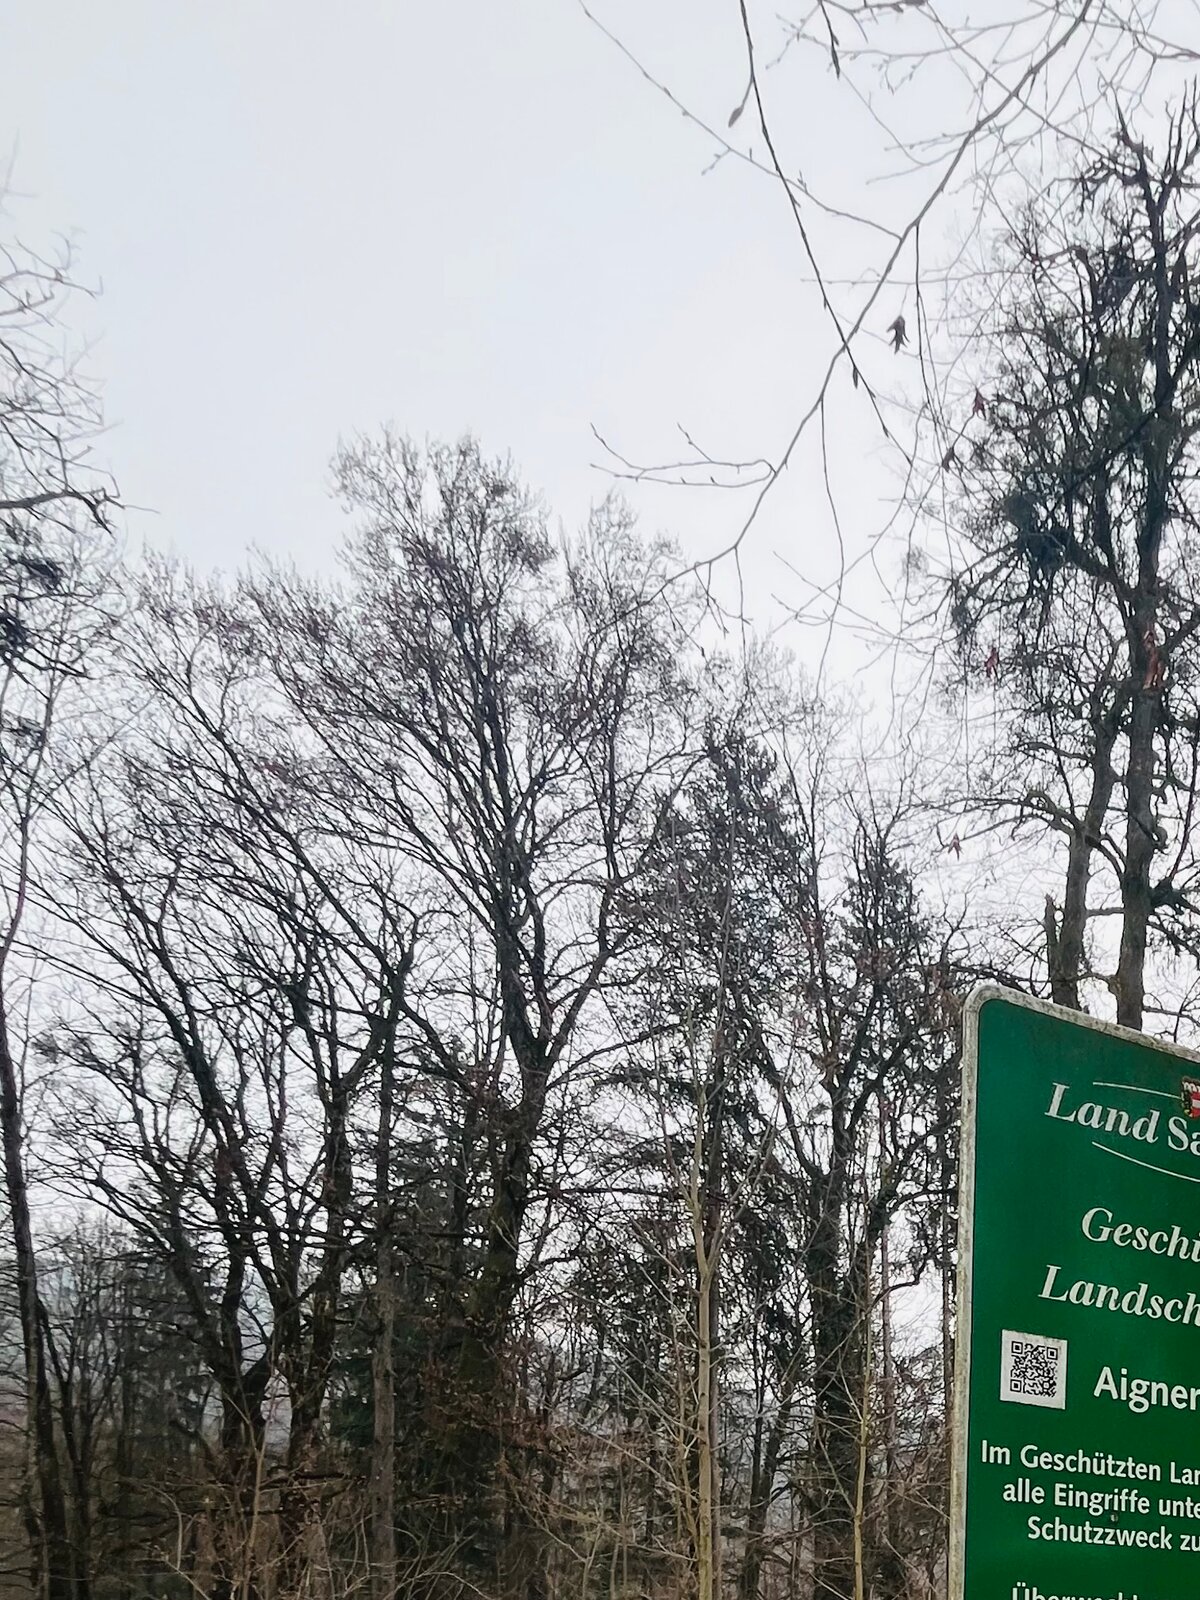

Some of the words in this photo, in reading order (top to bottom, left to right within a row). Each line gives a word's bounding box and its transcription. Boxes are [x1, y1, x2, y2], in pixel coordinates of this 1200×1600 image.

[1044, 1082, 1159, 1143] Land
[1093, 1366, 1200, 1413] Aigner
[981, 1440, 1010, 1466] Im
[1020, 1444, 1161, 1481] Geschützten
[1003, 1478, 1045, 1504] alle
[1054, 1483, 1150, 1516] Eingriffe
[1027, 1516, 1172, 1550] Schutzzweck
